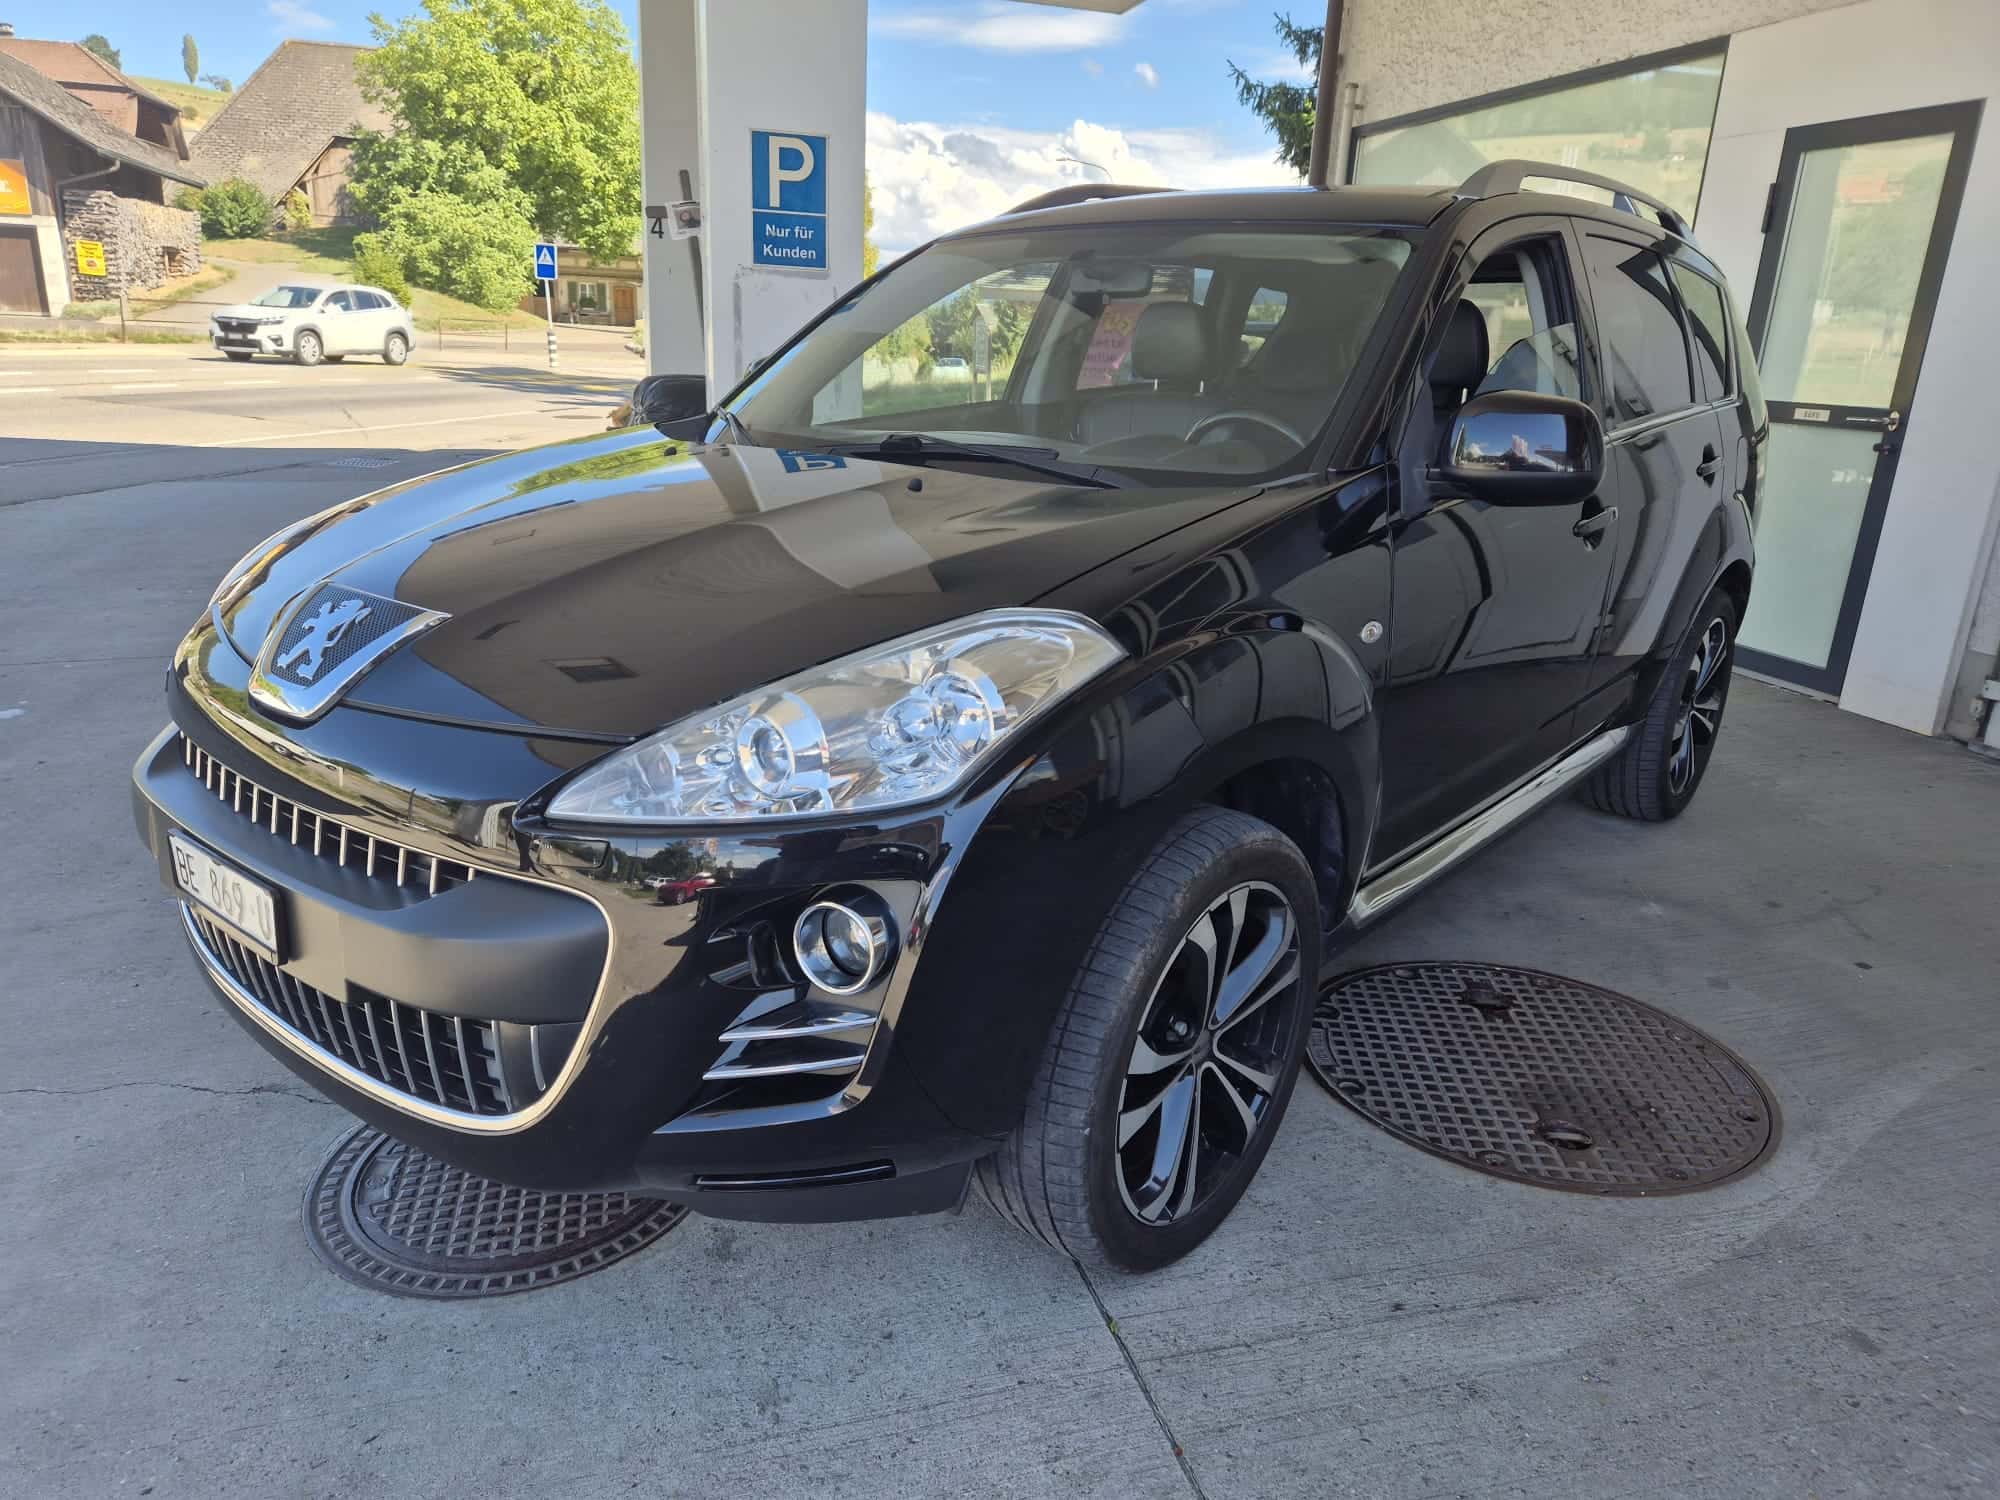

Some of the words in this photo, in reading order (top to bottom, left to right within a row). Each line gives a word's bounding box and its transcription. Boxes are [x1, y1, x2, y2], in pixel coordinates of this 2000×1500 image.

[768, 135, 815, 208] P
[650, 216, 665, 239] 4
[765, 223, 790, 239] Nur
[794, 225, 814, 240] für
[763, 243, 816, 260] Kunden
[175, 845, 200, 894] BE
[209, 867, 244, 927] 869
